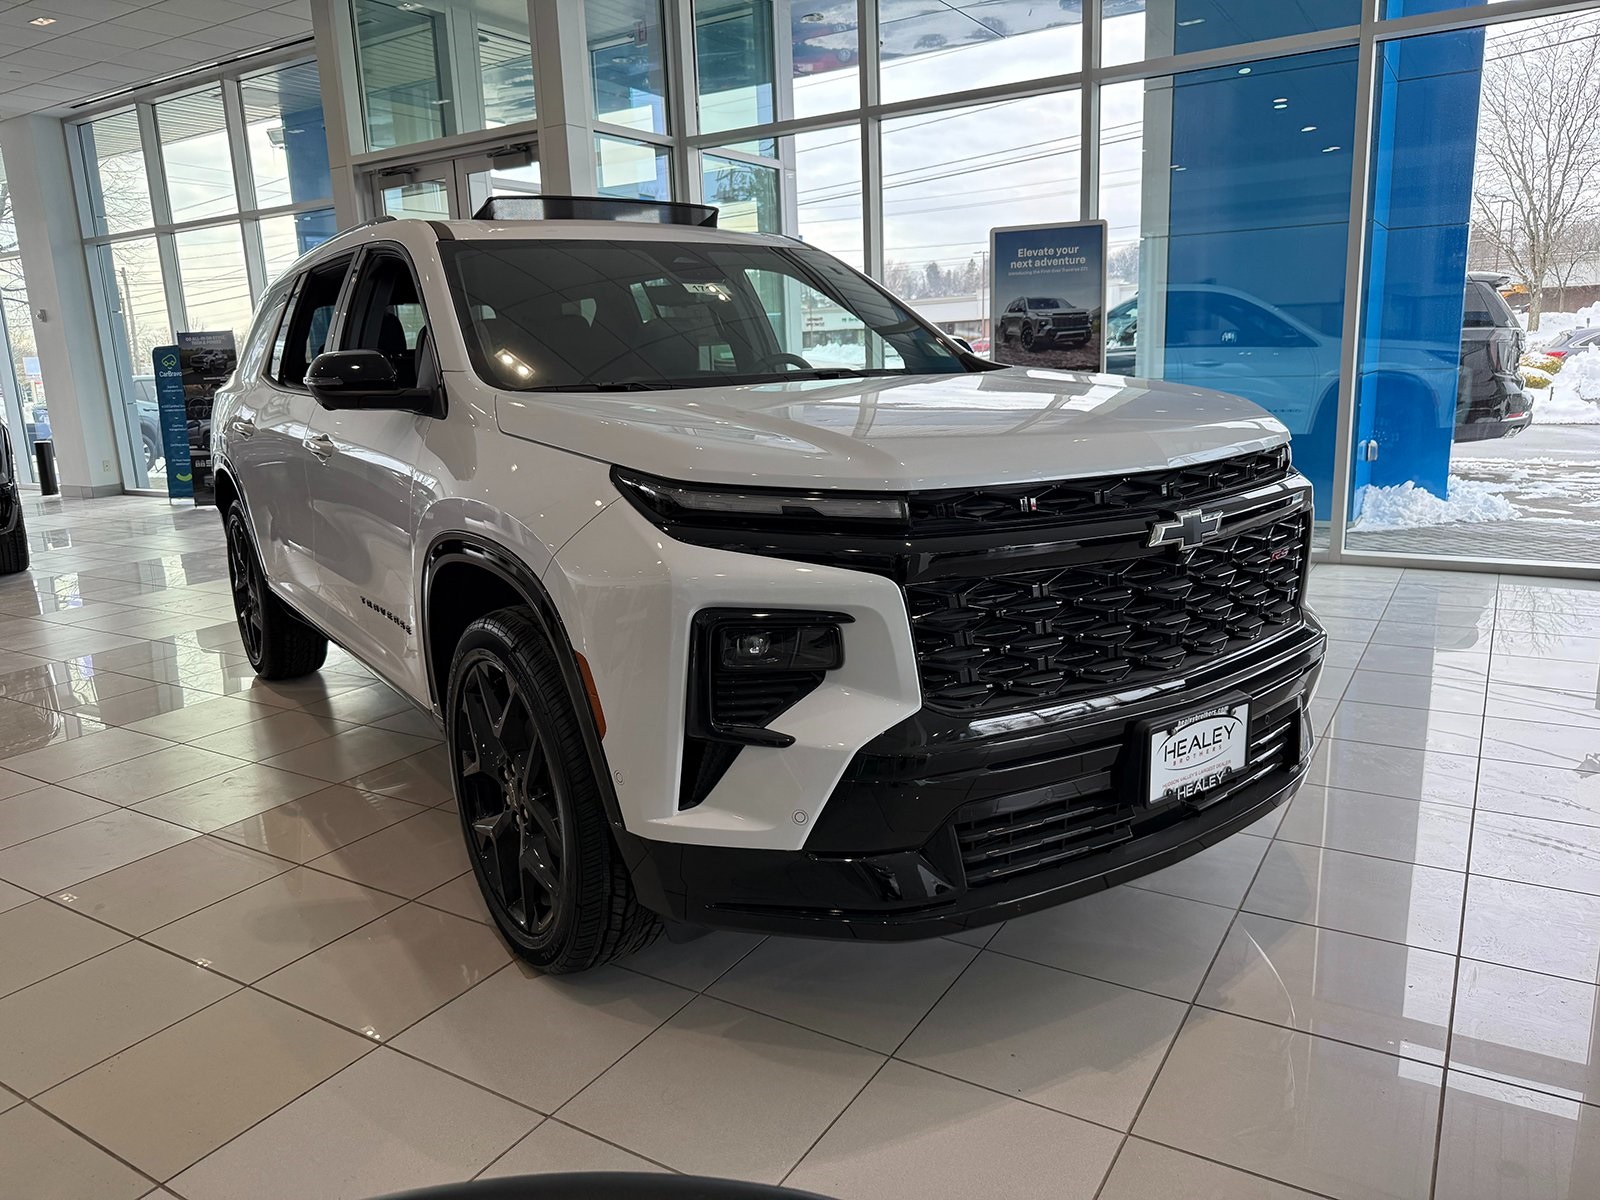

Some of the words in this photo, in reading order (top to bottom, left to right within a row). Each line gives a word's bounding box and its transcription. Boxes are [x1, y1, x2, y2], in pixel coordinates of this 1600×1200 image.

[1018, 247, 1054, 257] Elevate
[1056, 246, 1079, 256] your
[1010, 260, 1032, 269] next
[1034, 257, 1086, 267] adventure
[1271, 546, 1290, 560] RS
[360, 595, 412, 635] TRAVERSE
[1163, 722, 1236, 762] HEALEY
[1173, 745, 1222, 766] BROTHERS
[1177, 770, 1225, 800] HEALEY
